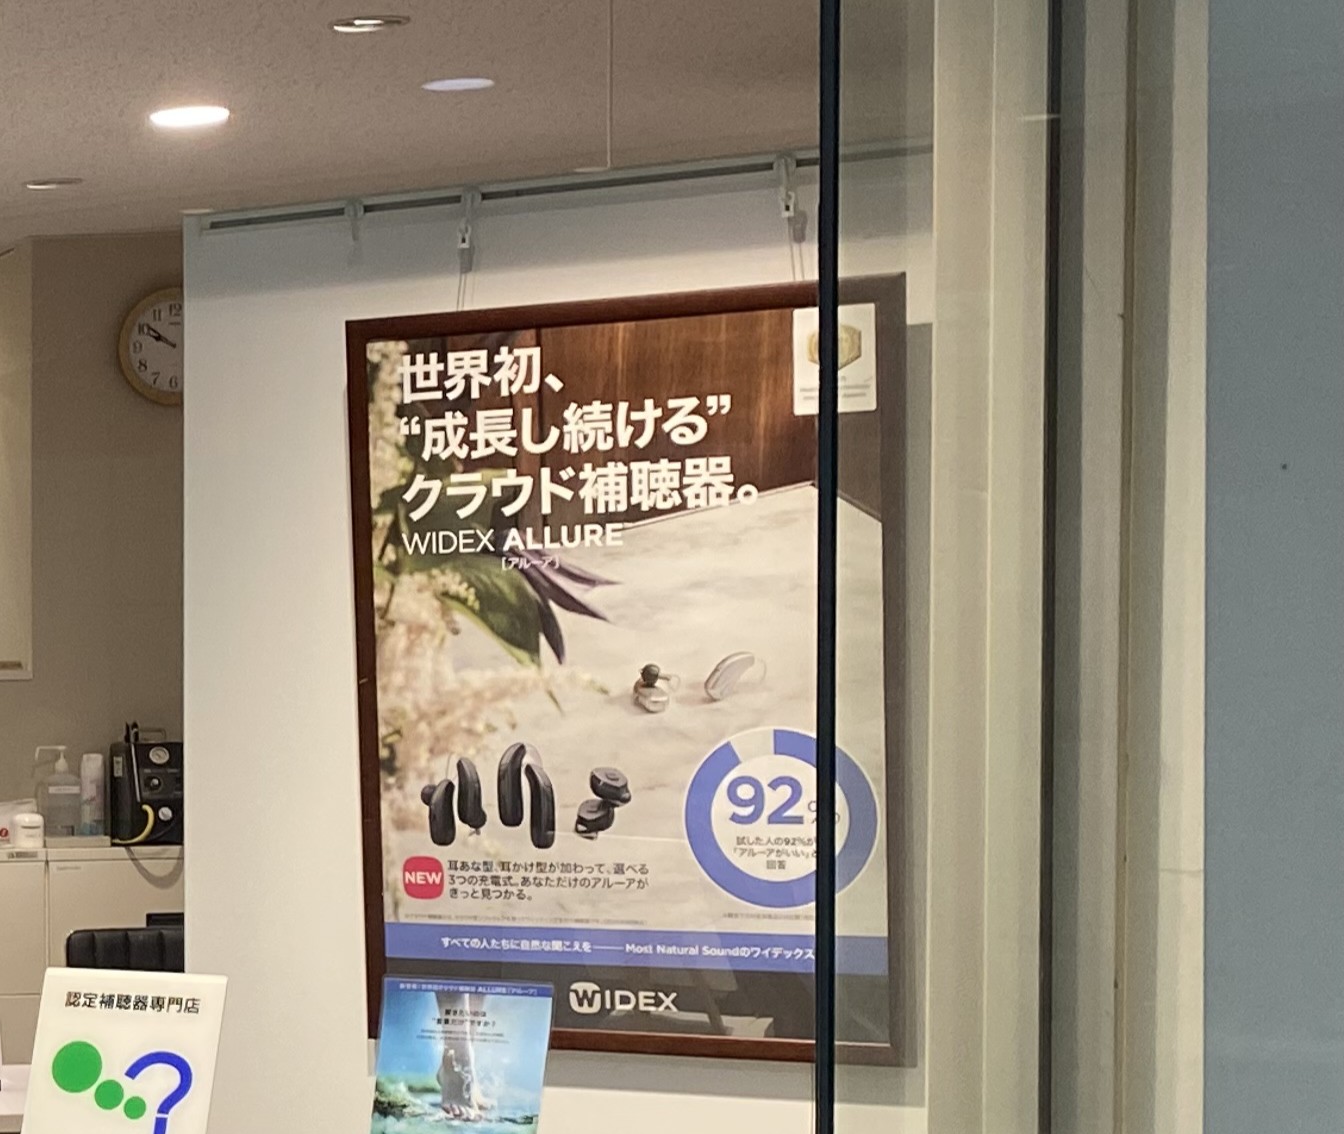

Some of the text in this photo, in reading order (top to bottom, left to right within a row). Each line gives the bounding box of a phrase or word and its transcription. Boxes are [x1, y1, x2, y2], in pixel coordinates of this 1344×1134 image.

[399, 346, 564, 404] 世界初、
[402, 457, 758, 522] クラウド補聴器。
[402, 522, 623, 556] WIDEX ALLURE
[404, 871, 443, 885] NEW
[656, 943, 699, 956] Natural
[64, 991, 201, 1014] 認定補聴器専門店
[568, 981, 678, 1014] WIDEX
